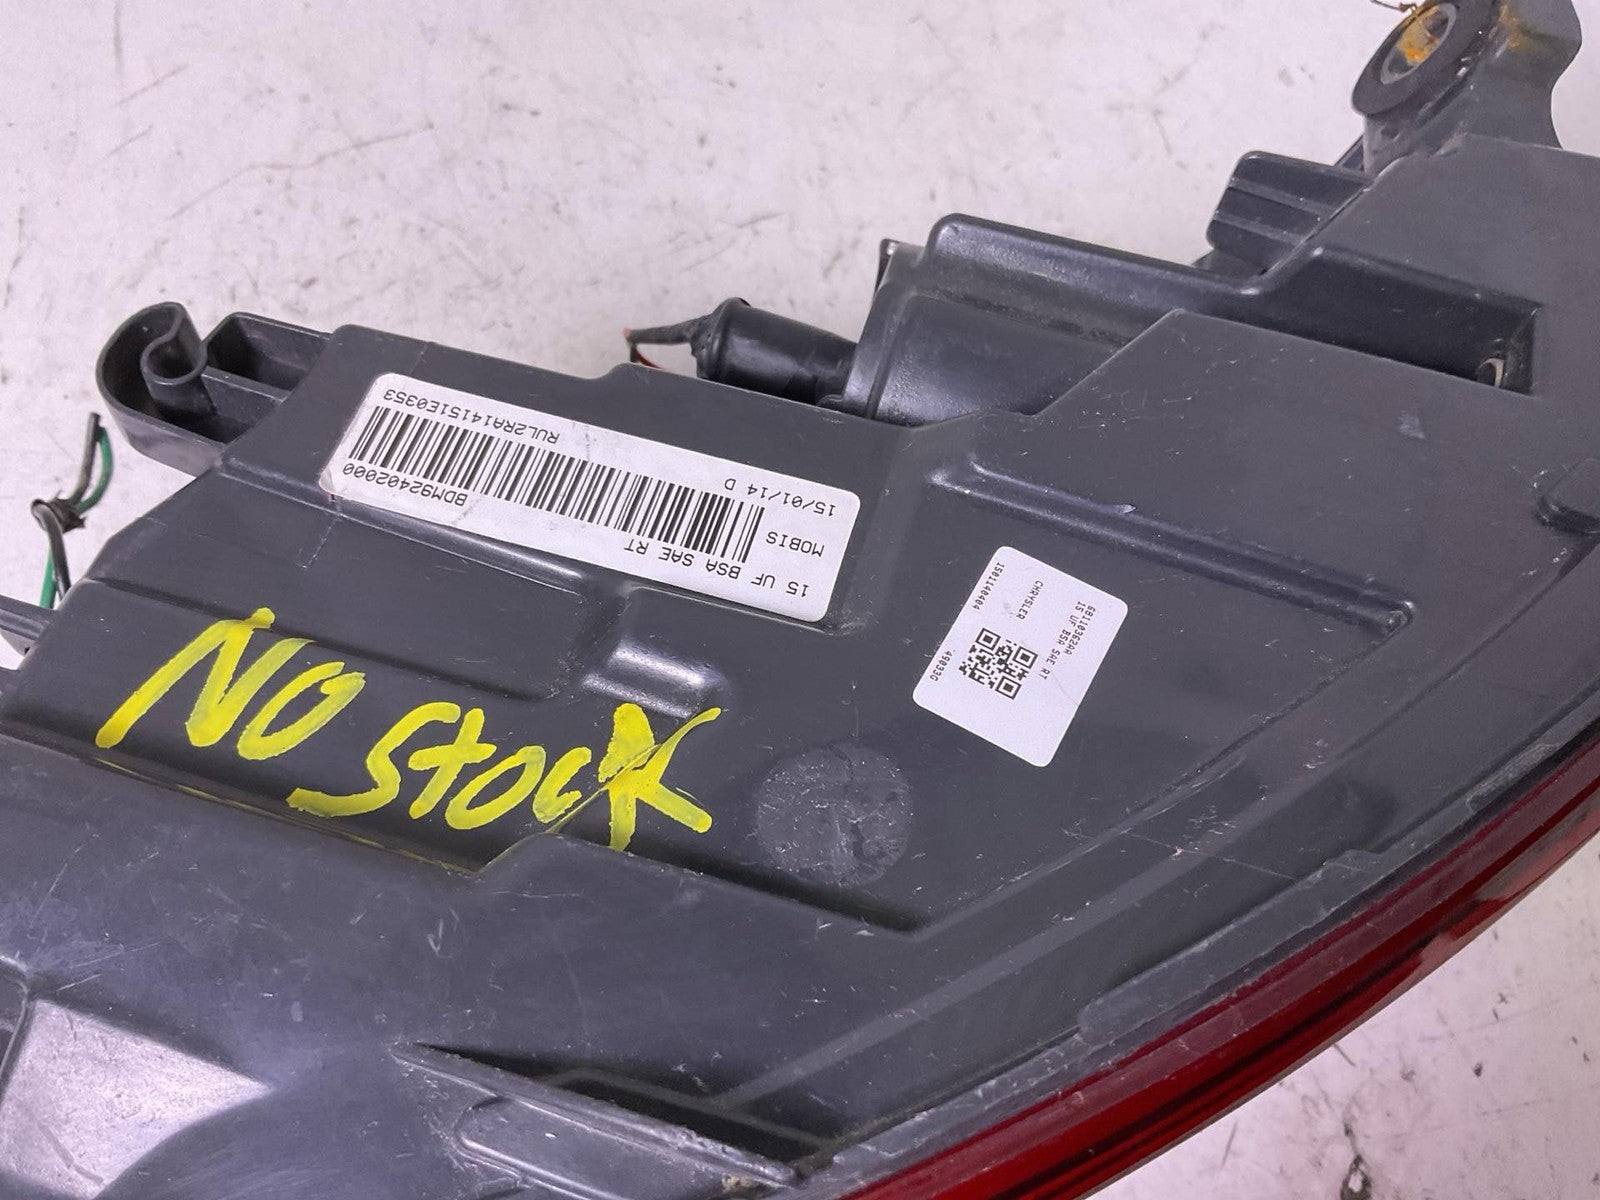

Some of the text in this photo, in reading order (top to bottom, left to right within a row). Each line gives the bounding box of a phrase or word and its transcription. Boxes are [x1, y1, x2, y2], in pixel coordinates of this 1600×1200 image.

[383, 389, 560, 444] RUL2RA14151E0353
[343, 463, 468, 507] BDM92402000
[724, 478, 836, 517] 15/01/14 D
[623, 539, 809, 597] 15 UF BSA SAE RT
[766, 531, 825, 557] MOBIS
[1016, 580, 1044, 620] CHRYSLER
[1038, 601, 1087, 681] 15 UF BSA SAE RT
[95, 607, 366, 760] NO
